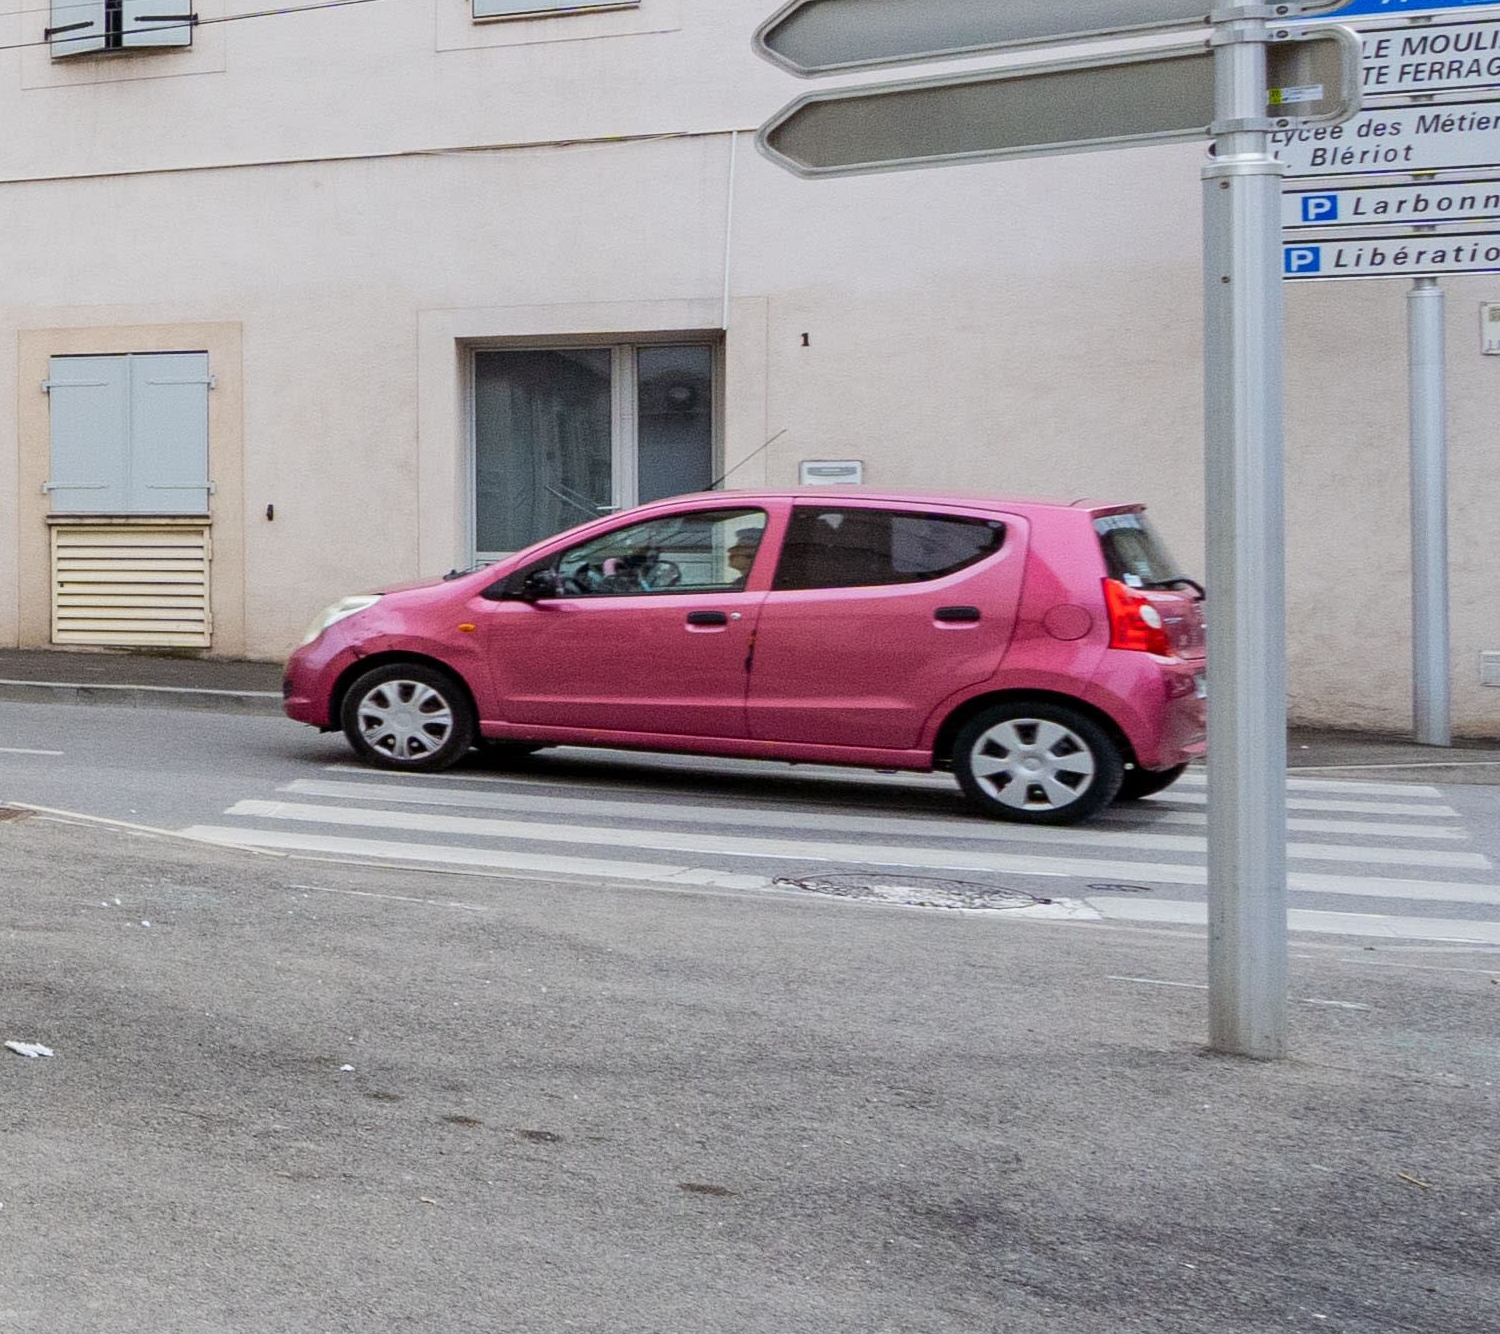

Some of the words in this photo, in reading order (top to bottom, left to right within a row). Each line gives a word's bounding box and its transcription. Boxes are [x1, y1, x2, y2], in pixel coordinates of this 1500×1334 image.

[1401, 28, 1500, 57] MOULI
[1357, 118, 1402, 138] des
[1310, 143, 1414, 167] Blériot
[800, 332, 811, 348] 1
